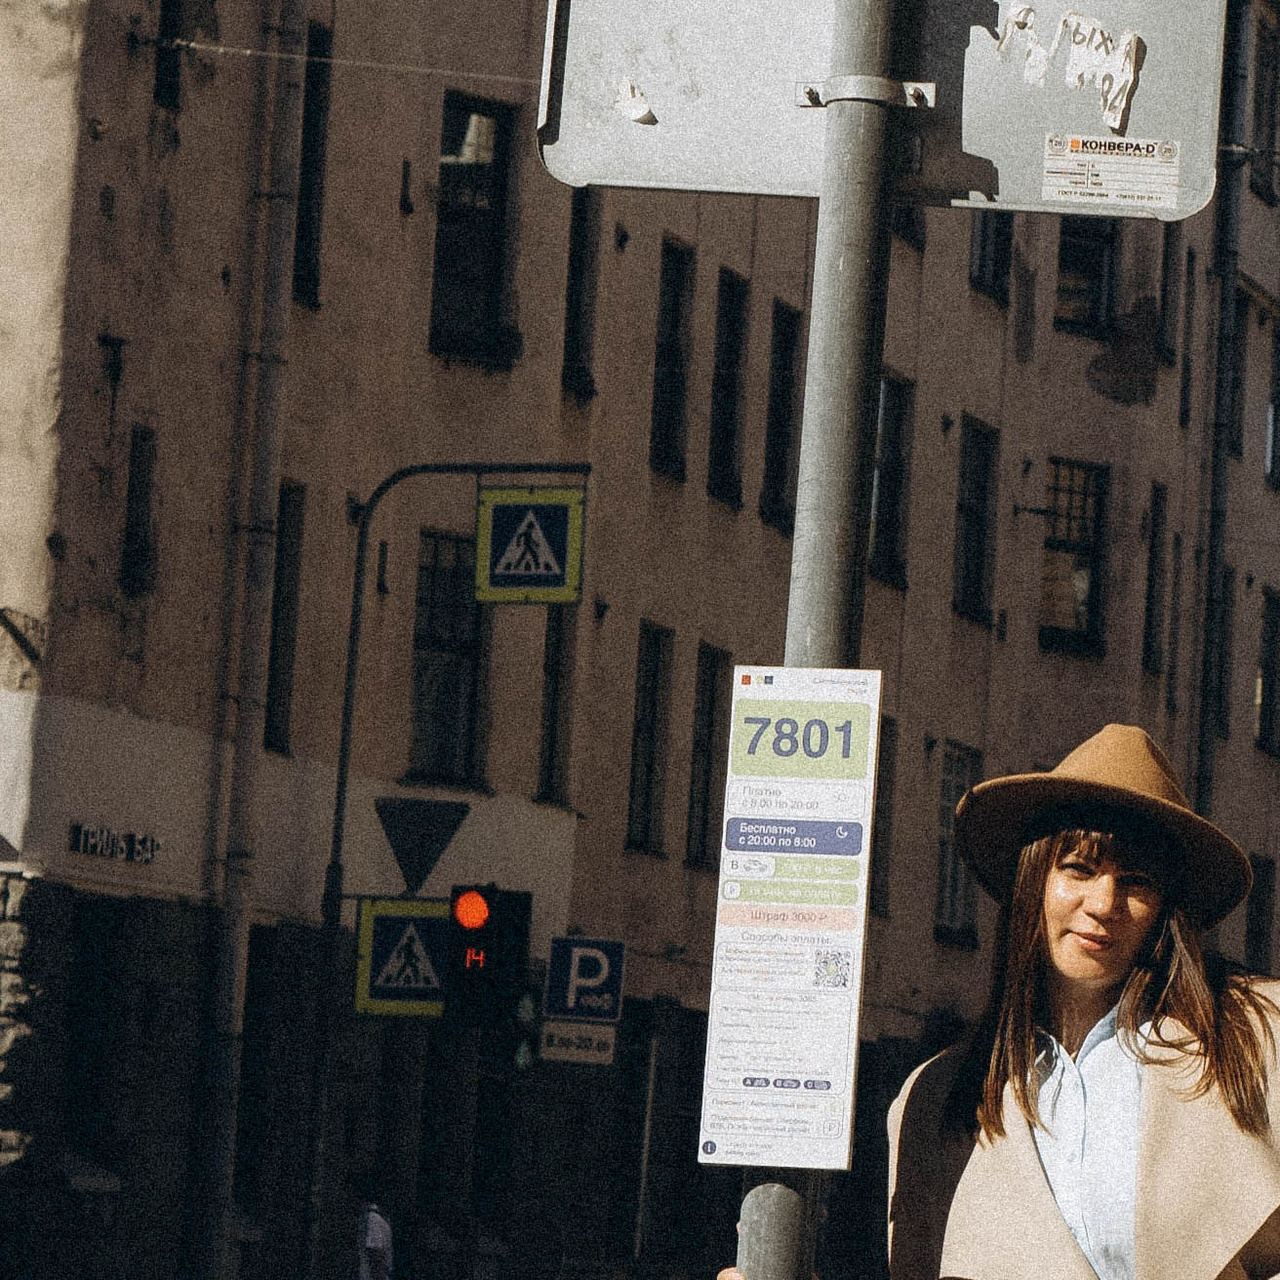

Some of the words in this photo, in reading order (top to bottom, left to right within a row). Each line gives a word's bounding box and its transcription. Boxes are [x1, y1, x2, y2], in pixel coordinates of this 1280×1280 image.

[743, 716, 854, 759] 7801
[739, 822, 797, 835] Бесплатно
[738, 837, 746, 845] с
[747, 835, 776, 846] 20:00
[778, 837, 791, 846] по
[793, 836, 817, 848] 8:00
[750, 910, 789, 922] Штраф
[466, 947, 487, 969] 14
[567, 946, 610, 1009] P
